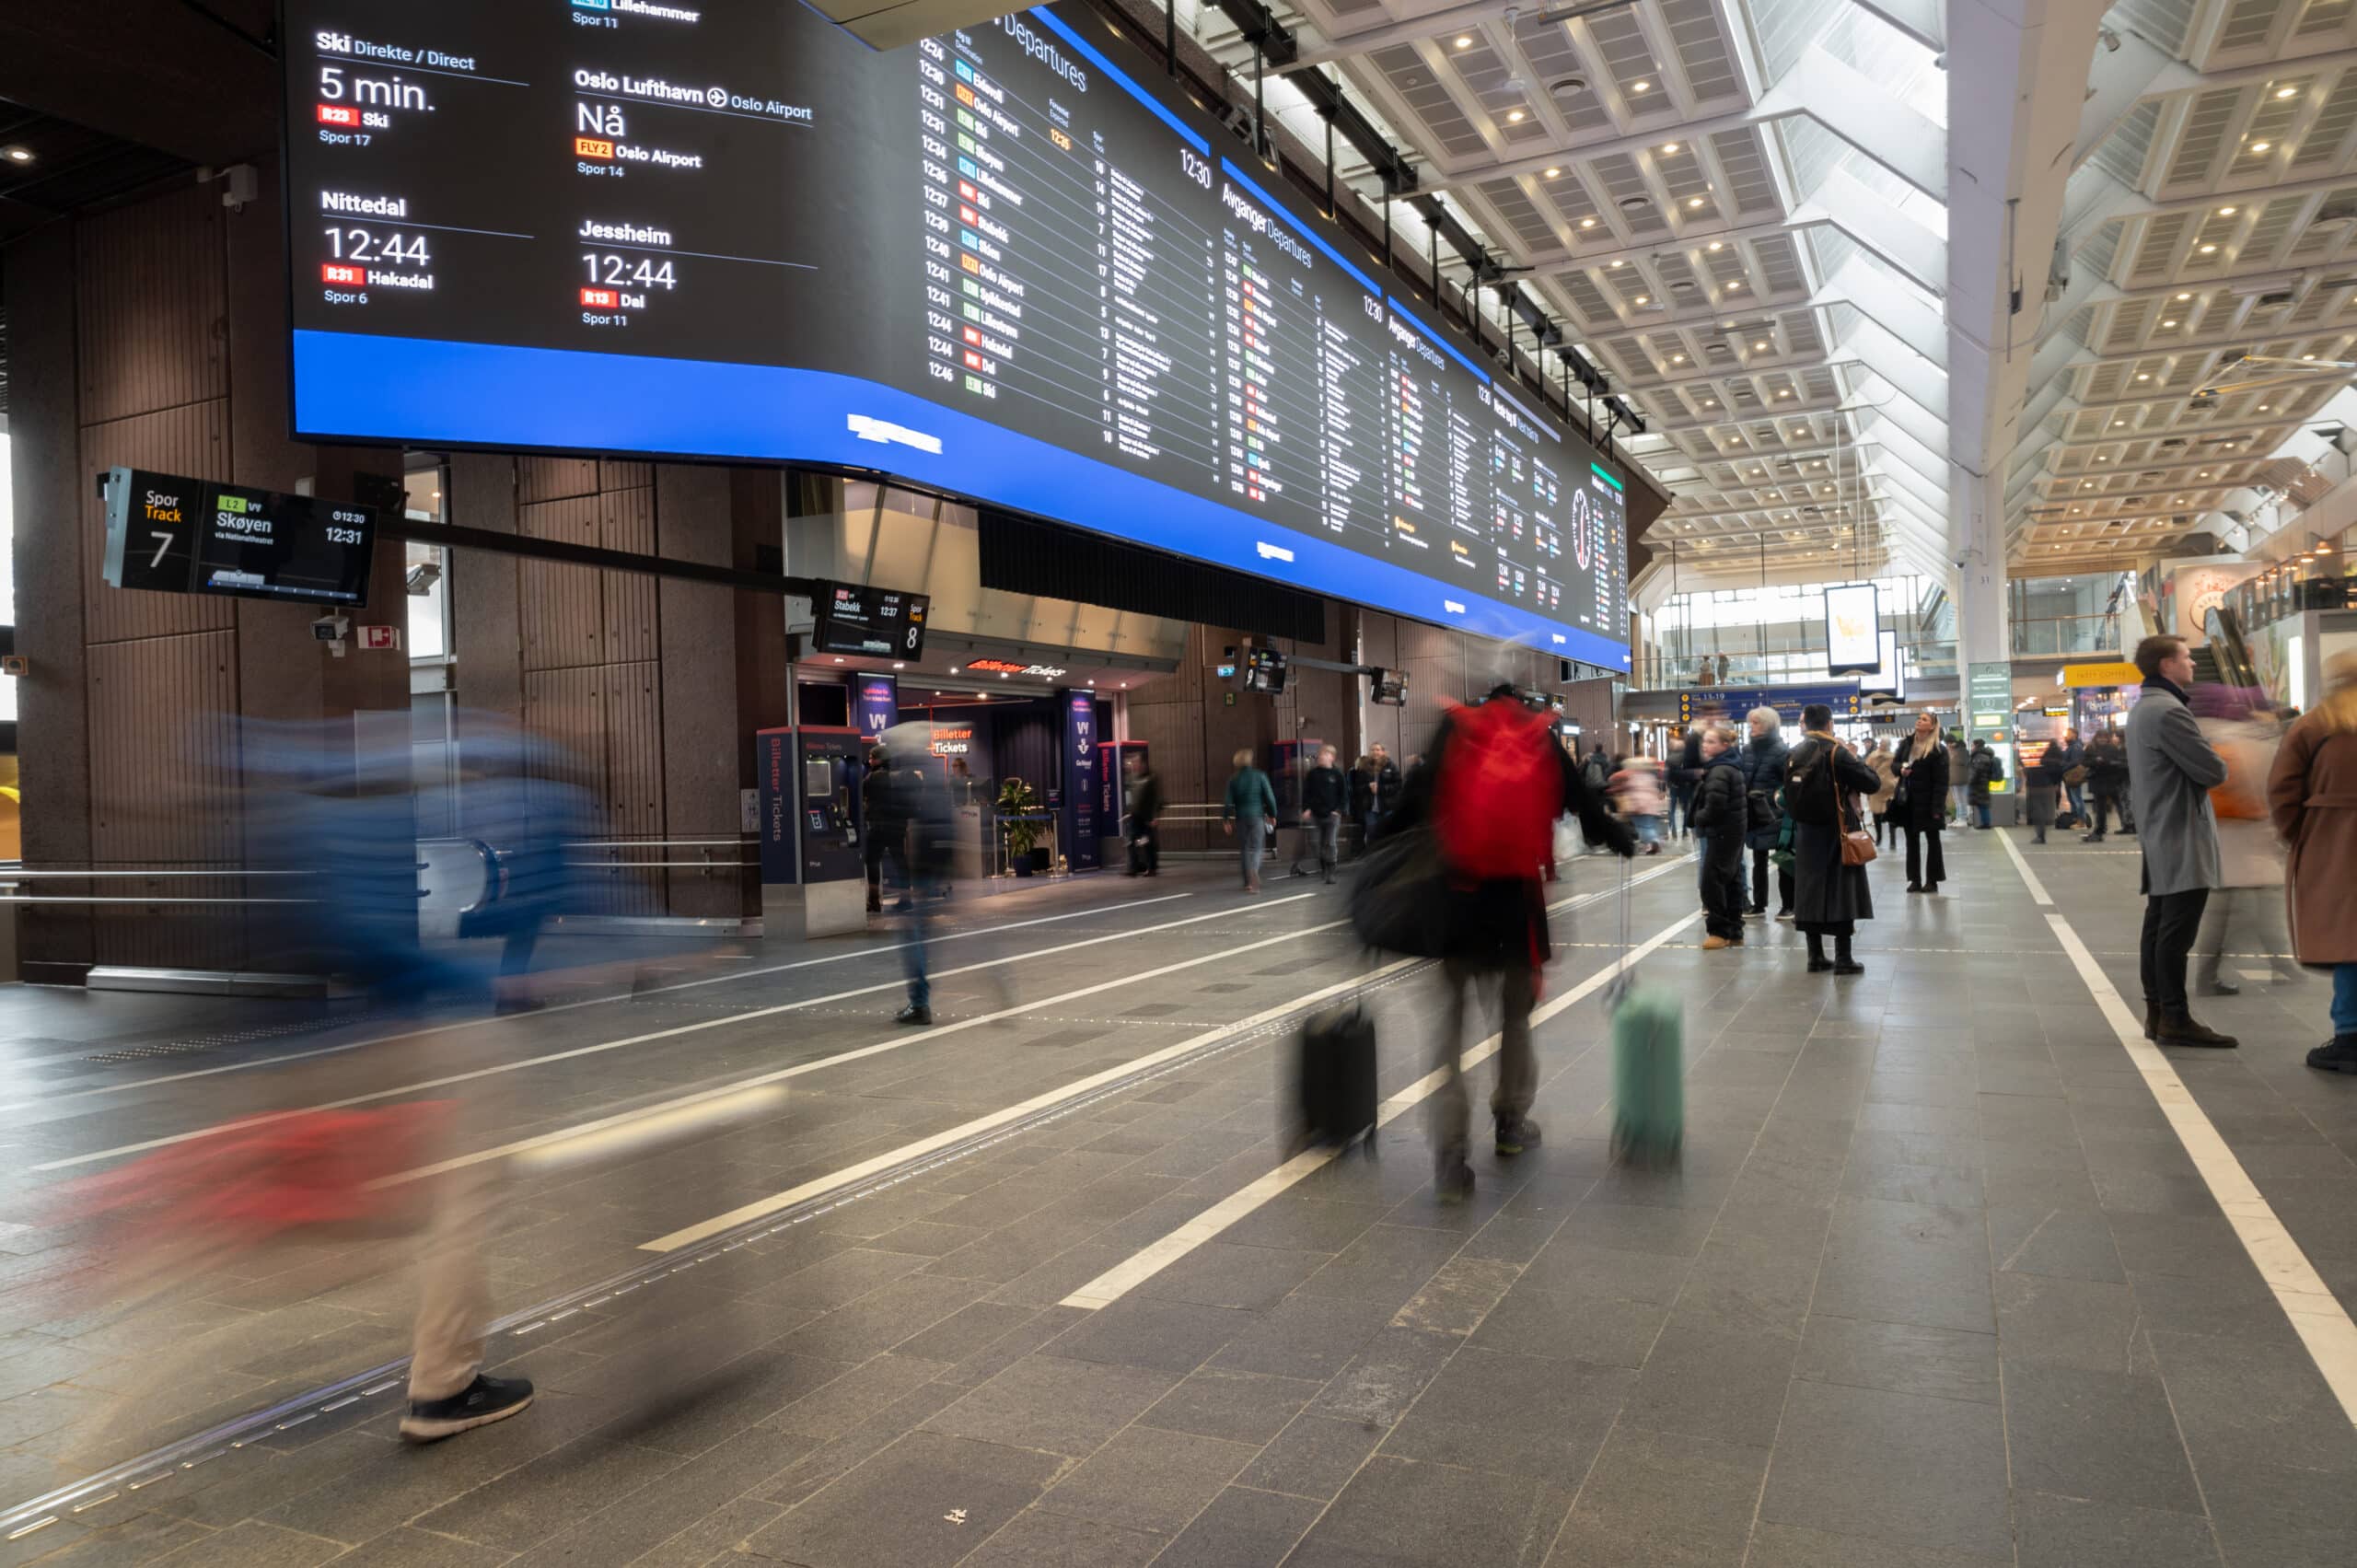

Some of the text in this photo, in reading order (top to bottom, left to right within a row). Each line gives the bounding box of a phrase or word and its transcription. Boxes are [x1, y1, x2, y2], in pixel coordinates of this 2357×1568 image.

[573, 12, 618, 29] Spor 11
[611, 0, 701, 22] Lillehammer
[317, 32, 476, 71] Ski Direkte / Direct
[1004, 14, 1087, 93] Departures
[320, 67, 435, 110] 5 min.
[575, 70, 813, 120] Oslo Lufthavn Oslo Airport
[921, 85, 945, 110] 12:31
[363, 112, 389, 128] Ski
[577, 101, 625, 136] Nå
[920, 60, 945, 85] 12:30
[974, 98, 992, 119] Oslo
[993, 110, 1019, 137] Airport
[1096, 180, 1104, 195] 14
[922, 110, 945, 134] 12:31
[319, 130, 371, 145] Spor 17
[616, 145, 648, 160] Oslo
[651, 150, 702, 168] Airport
[577, 162, 624, 178] Spor 14
[1180, 148, 1211, 189] 12:30
[322, 191, 406, 216] Nittedal
[923, 135, 946, 159] 12:34
[1097, 243, 1106, 257] 11
[923, 185, 948, 208] 12:37
[580, 220, 671, 245] Jessheim
[1223, 183, 1267, 233] Avganger
[1268, 218, 1311, 268] Departures
[325, 228, 430, 266] 12:44
[368, 271, 434, 289] Hakadal
[583, 253, 677, 290] 12:44
[926, 261, 949, 283] 12:41
[979, 264, 997, 283] Oslo
[998, 272, 1024, 297] Airport
[324, 290, 367, 305] Spor 6
[621, 293, 645, 308] Dal
[927, 286, 950, 308] 12:41
[582, 312, 627, 326] Spor 11
[928, 312, 952, 332] 12:44
[1388, 315, 1445, 371] Avganger Departures
[928, 336, 952, 357] 12:44
[1103, 410, 1110, 423] 11
[929, 362, 953, 382] 12:46
[145, 490, 178, 508] Spor
[145, 505, 181, 523] Track
[217, 512, 365, 533] Skøyen 12:30
[326, 527, 362, 544] 12:31
[150, 531, 174, 568] 7
[834, 599, 861, 612] Stabekk
[880, 607, 898, 617] 12:37
[909, 612, 922, 621] Track
[911, 604, 923, 613] Spor
[907, 627, 917, 649] 8
[934, 728, 972, 739] Billetter
[935, 742, 968, 753] Tickets
[771, 738, 782, 842] Billetter Tickets
